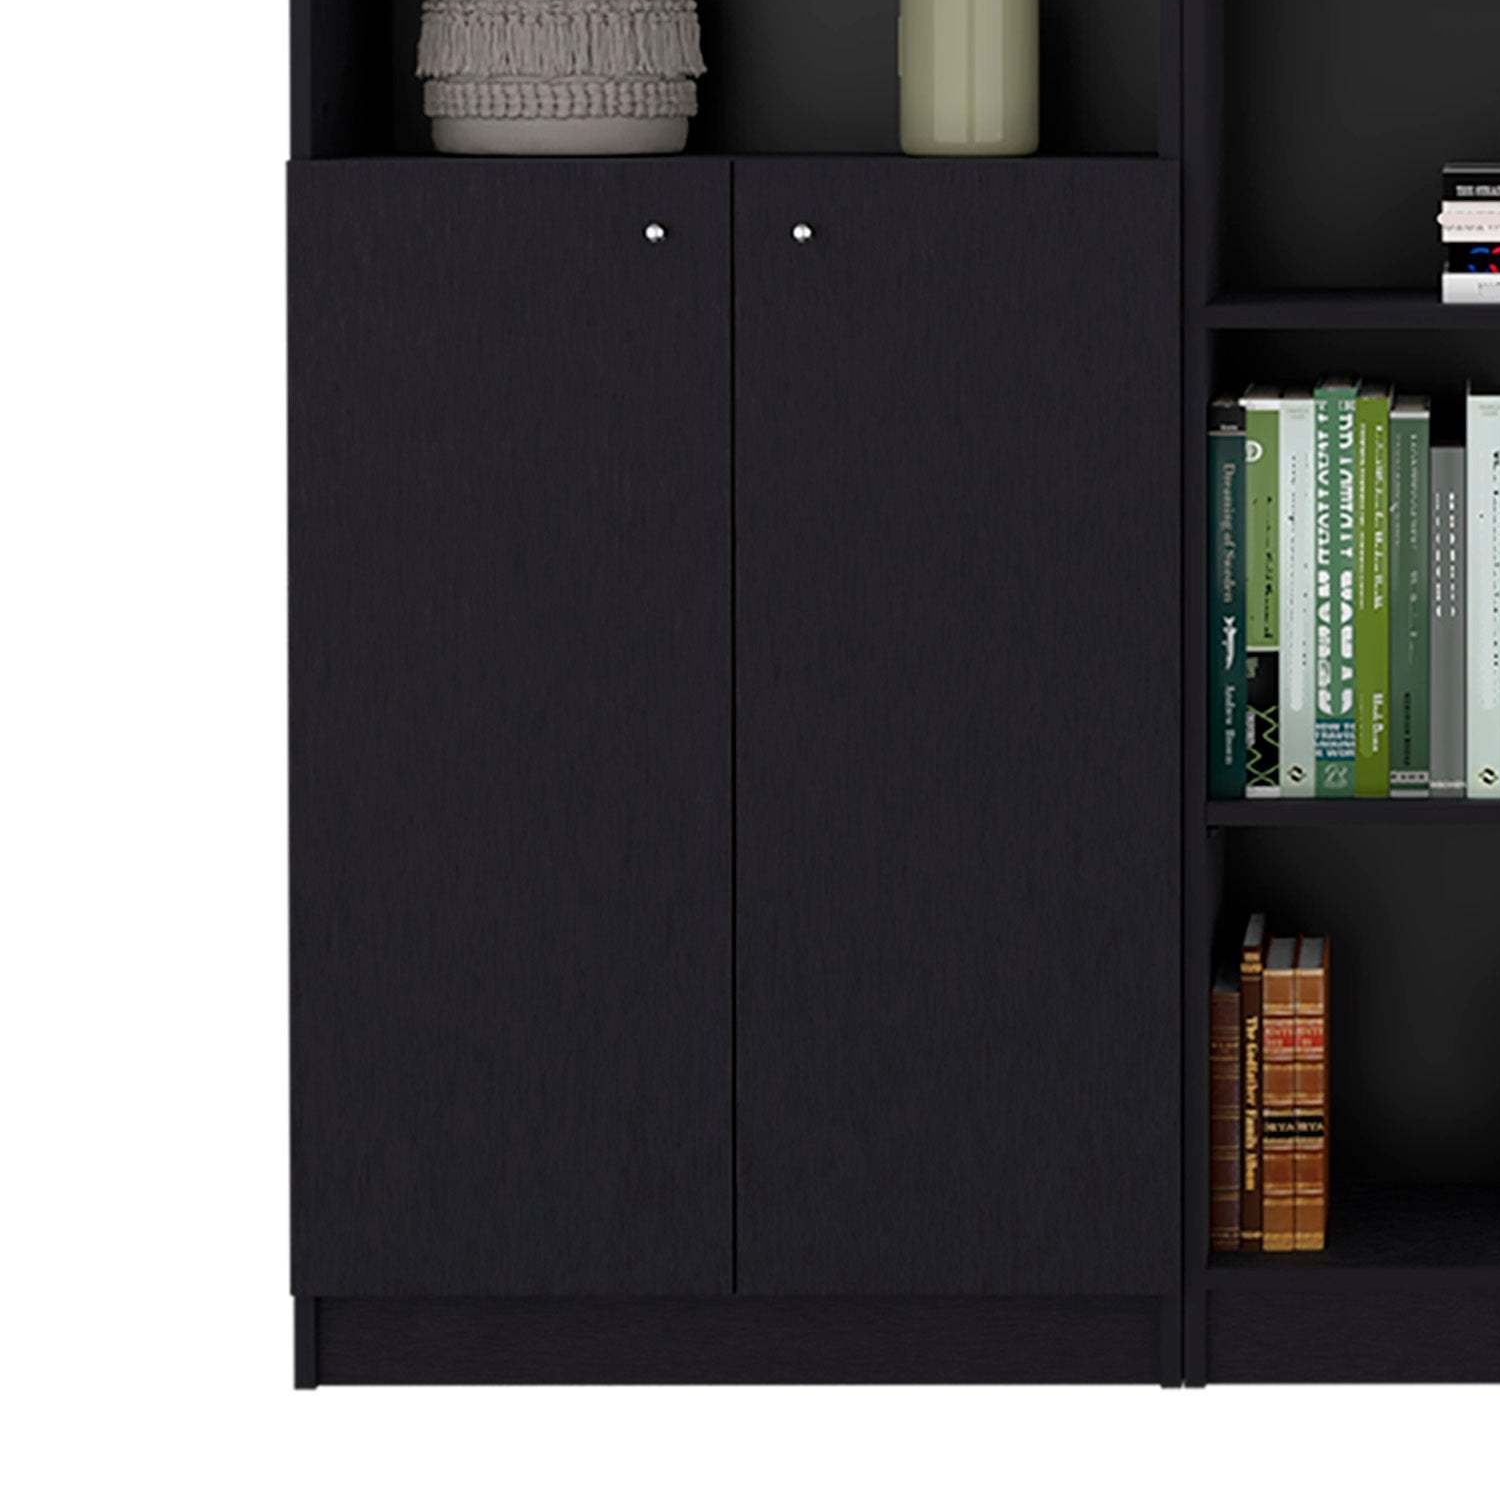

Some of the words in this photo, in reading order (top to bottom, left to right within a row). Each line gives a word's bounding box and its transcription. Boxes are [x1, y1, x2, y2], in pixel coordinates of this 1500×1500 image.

[1219, 463, 1236, 530] Dreaming
[1219, 532, 1236, 548] of
[1222, 550, 1236, 603] Sweden
[1244, 1016, 1259, 1041] The
[1244, 1043, 1259, 1106] Godfather
[1243, 1109, 1259, 1150] Family
[1244, 1152, 1259, 1191] Album
